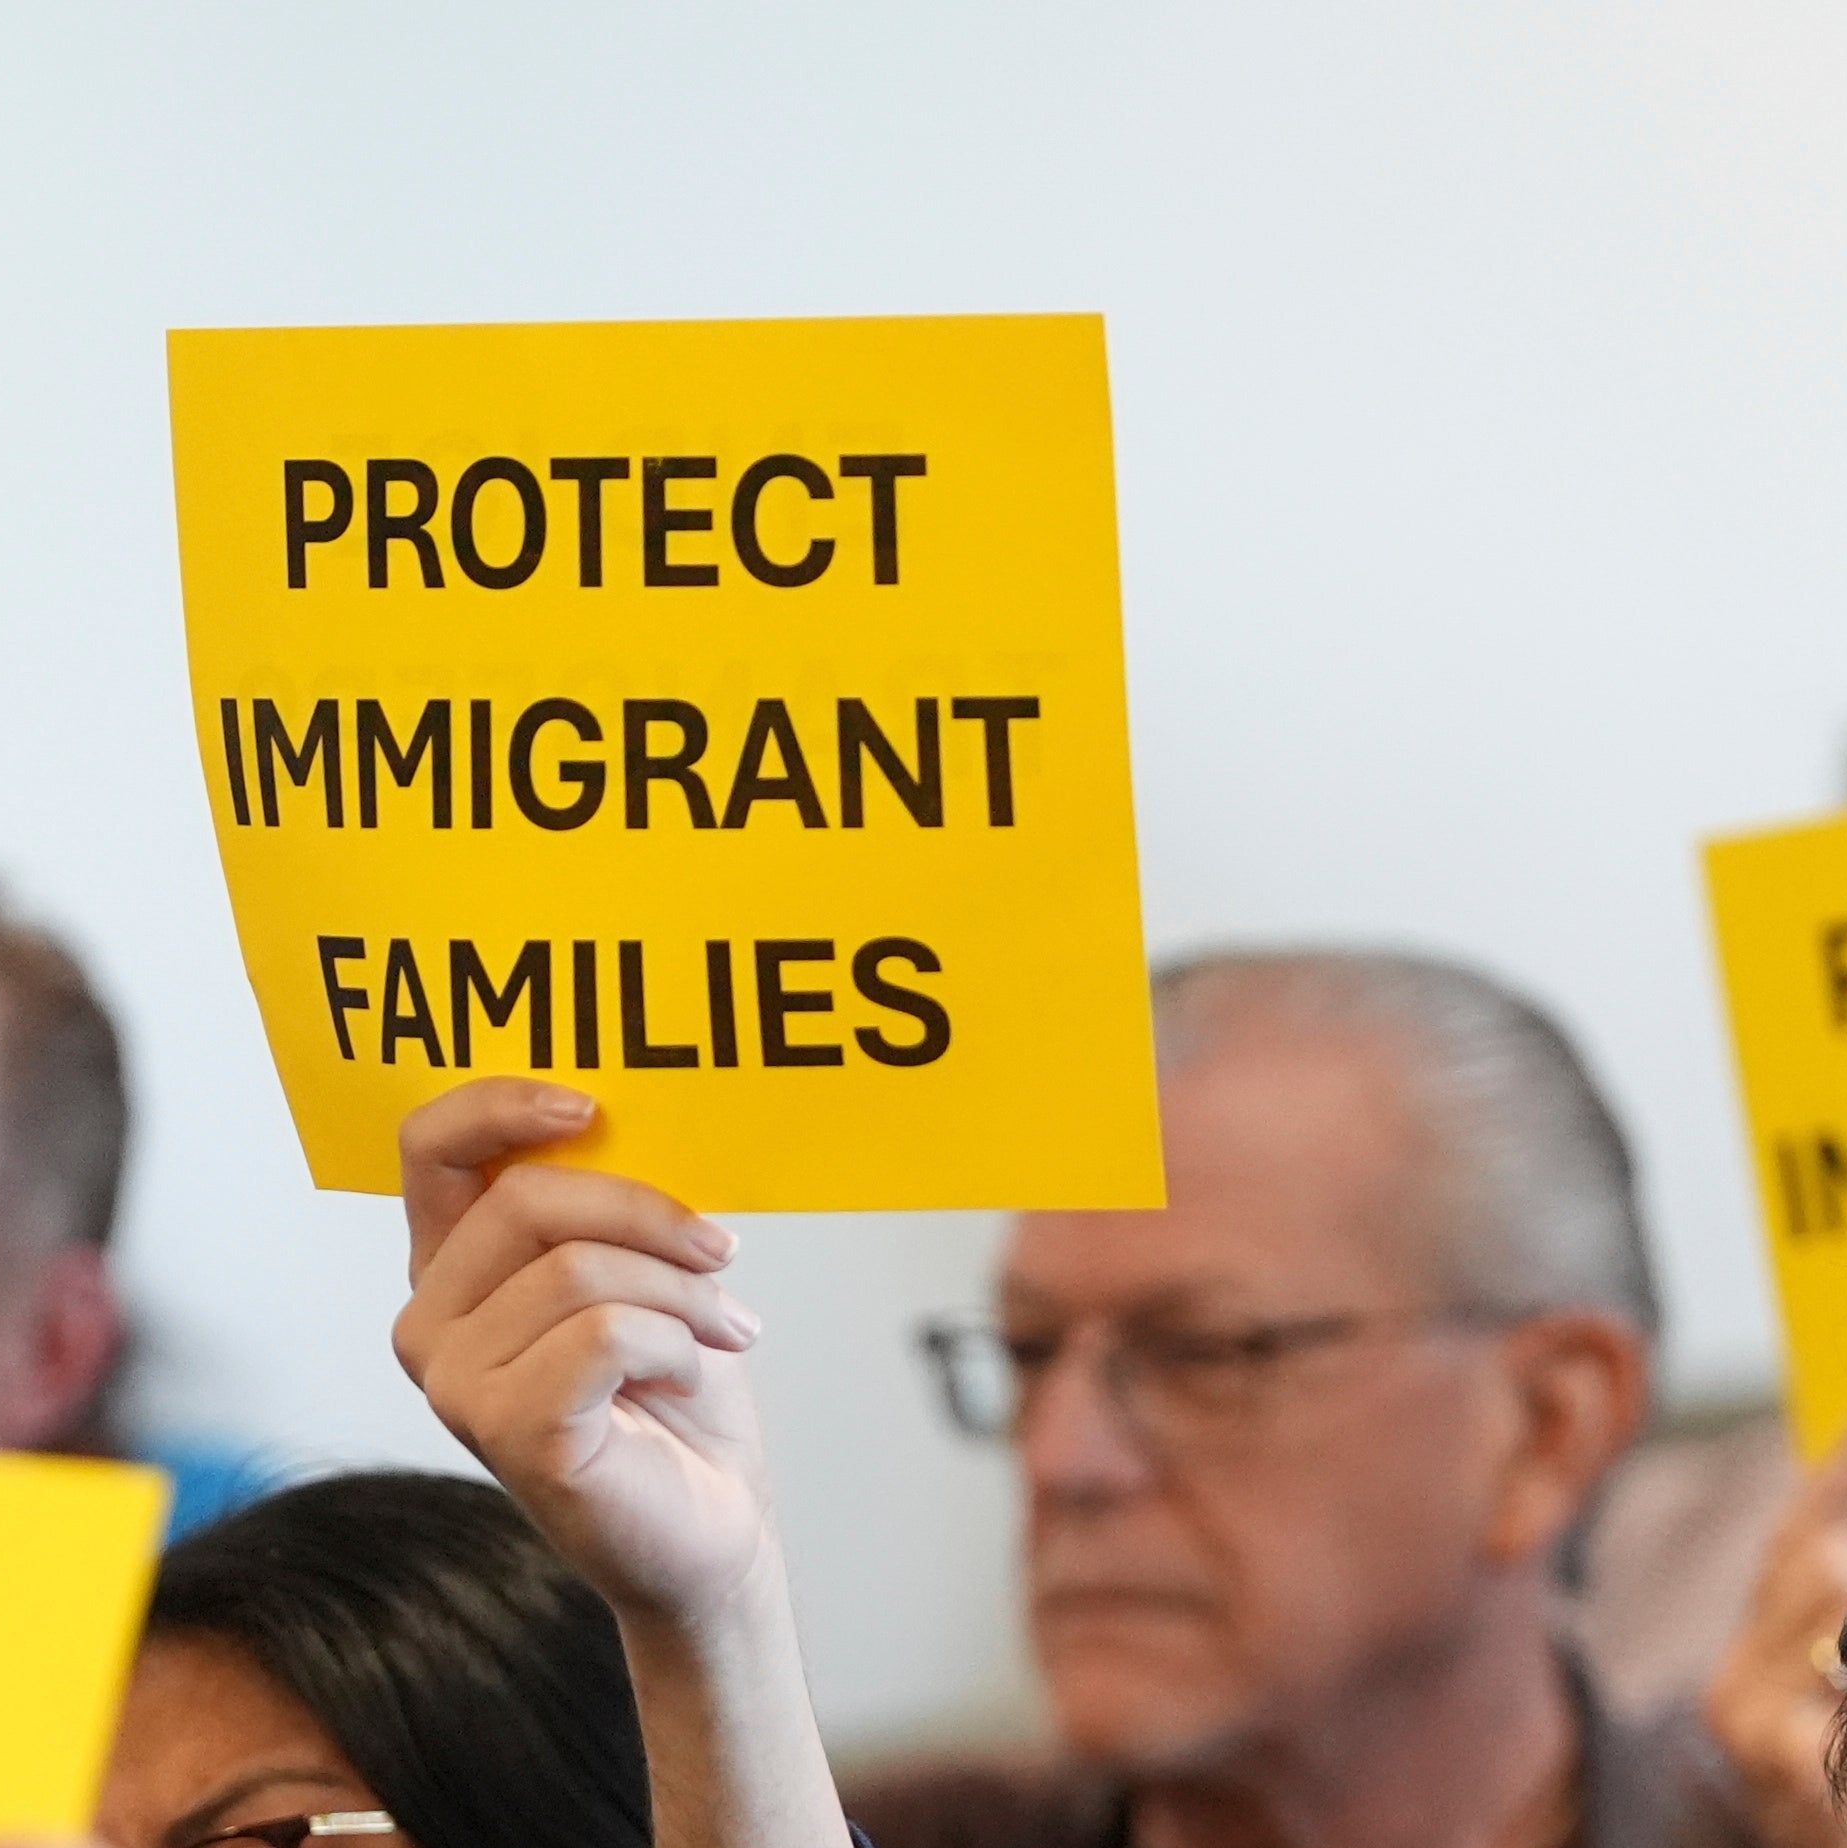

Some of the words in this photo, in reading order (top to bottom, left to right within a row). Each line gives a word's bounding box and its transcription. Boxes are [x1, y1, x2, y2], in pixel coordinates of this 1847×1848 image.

[283, 453, 928, 591] PROTECT
[219, 695, 1041, 832] IMMIGRANT
[316, 934, 952, 1070] FAMILIES
